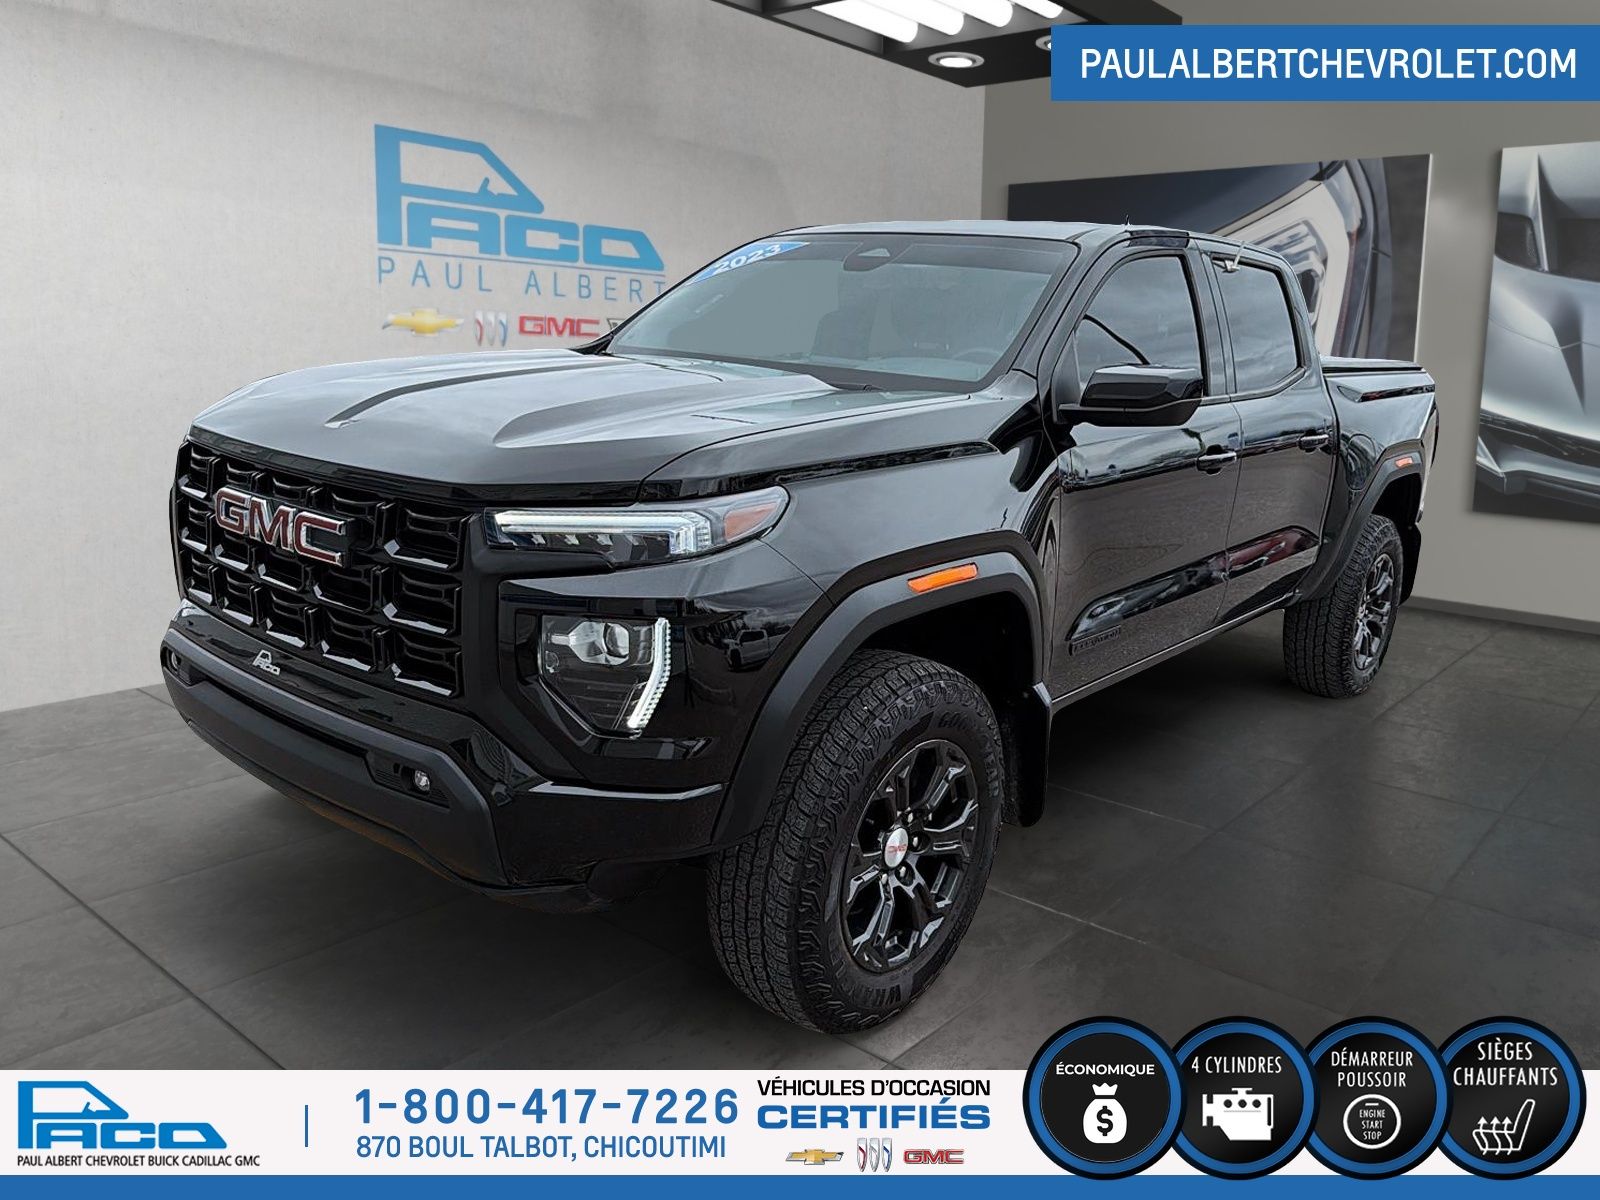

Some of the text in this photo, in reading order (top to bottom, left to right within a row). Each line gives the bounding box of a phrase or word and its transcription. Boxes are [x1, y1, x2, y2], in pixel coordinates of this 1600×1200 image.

[374, 124, 664, 271] PACO
[377, 256, 667, 304] PAUL ALBERT
[712, 244, 782, 276] 2023
[518, 314, 601, 339] GMC
[215, 486, 348, 567] GMC
